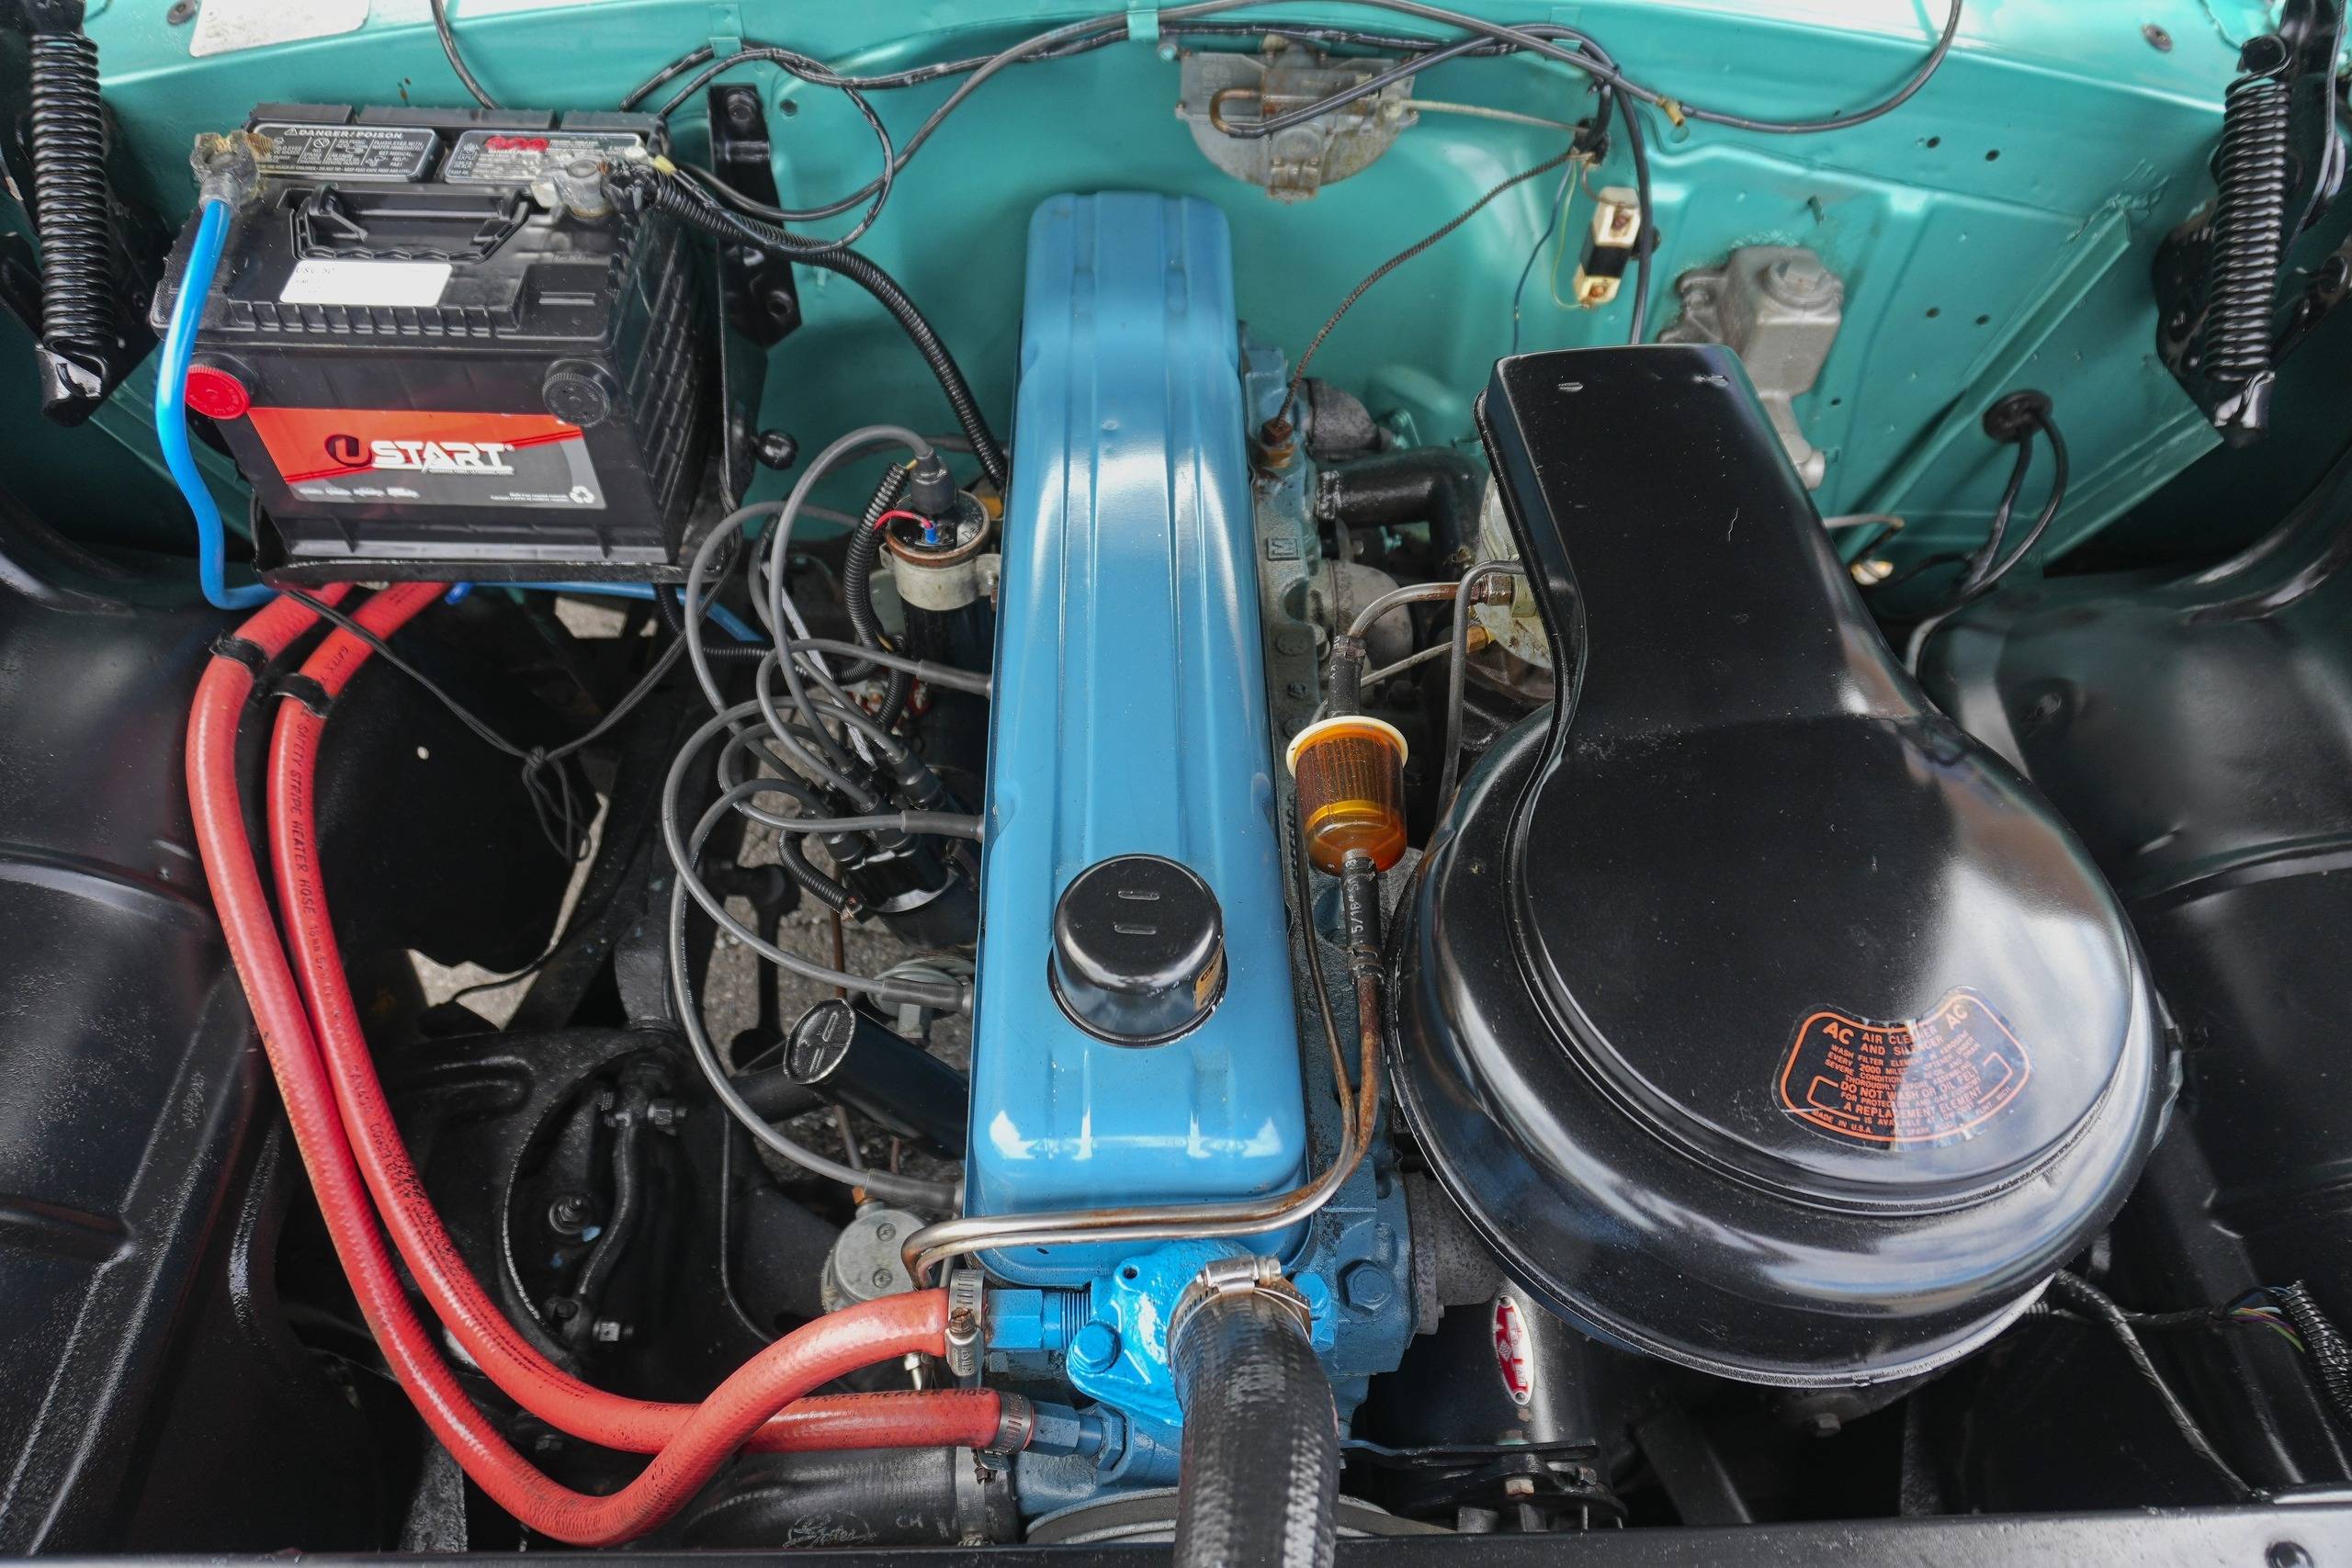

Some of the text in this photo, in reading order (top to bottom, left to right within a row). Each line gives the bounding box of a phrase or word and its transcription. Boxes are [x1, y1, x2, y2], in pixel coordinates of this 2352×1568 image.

[290, 770, 302, 816] STRIPE
[292, 820, 309, 872] HEATER
[299, 879, 316, 914] HOSE
[1823, 1021, 1854, 1044] AC
[1861, 1032, 1883, 1044] AIR
[1946, 1004, 1968, 1031] AC
[1860, 1043, 1885, 1055] AND
[1825, 1058, 1854, 1076] SEVERE
[1827, 1052, 1853, 1066] EVERY
[1859, 1064, 1881, 1075] 2000
[1858, 1055, 1883, 1066] FILTER
[1840, 1081, 1857, 1094] DO
[1860, 1087, 1883, 1100] NOT
[1921, 1088, 1936, 1099] OR
[1939, 1081, 1955, 1093] OIL
[1840, 1091, 1857, 1102] FOR
[1844, 1102, 1852, 1112] A
[1812, 1110, 1834, 1123] MADE
[1838, 1120, 1848, 1128] IN
[1864, 1117, 1872, 1125] IS
